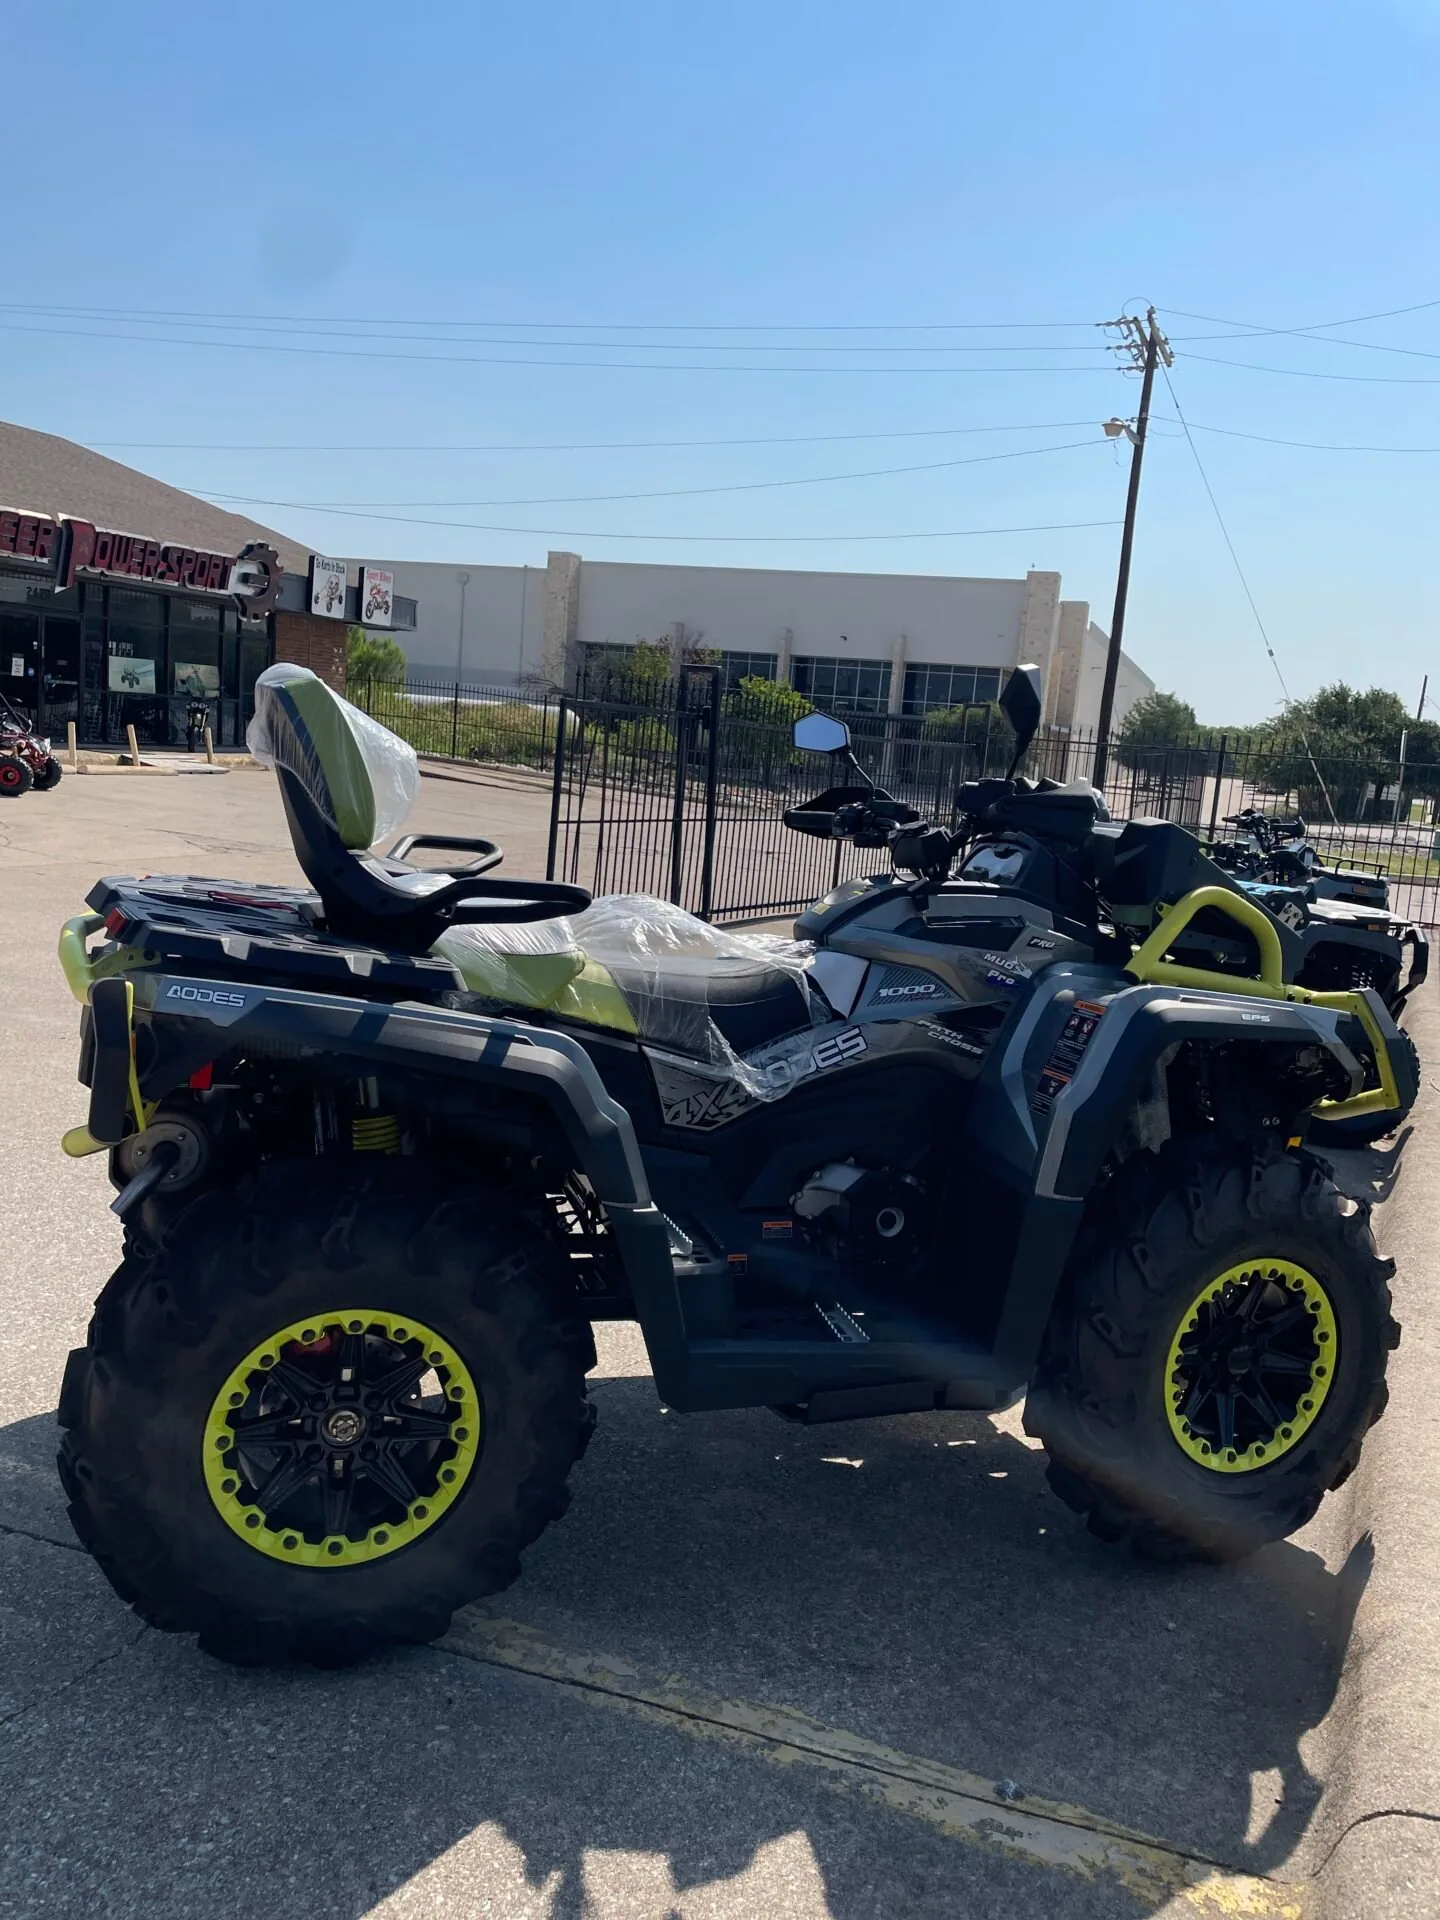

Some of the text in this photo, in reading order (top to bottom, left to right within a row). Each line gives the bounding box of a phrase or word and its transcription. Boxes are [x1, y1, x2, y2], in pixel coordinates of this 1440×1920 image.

[1029, 937, 1055, 949] PRO
[984, 953, 1016, 970] MUD
[166, 985, 246, 1008] AODES
[878, 984, 936, 998] 1000
[1241, 1013, 1271, 1023] EPS
[917, 1019, 964, 1040] PATH
[927, 1030, 985, 1055] CROSS
[750, 1026, 869, 1090] ODES
